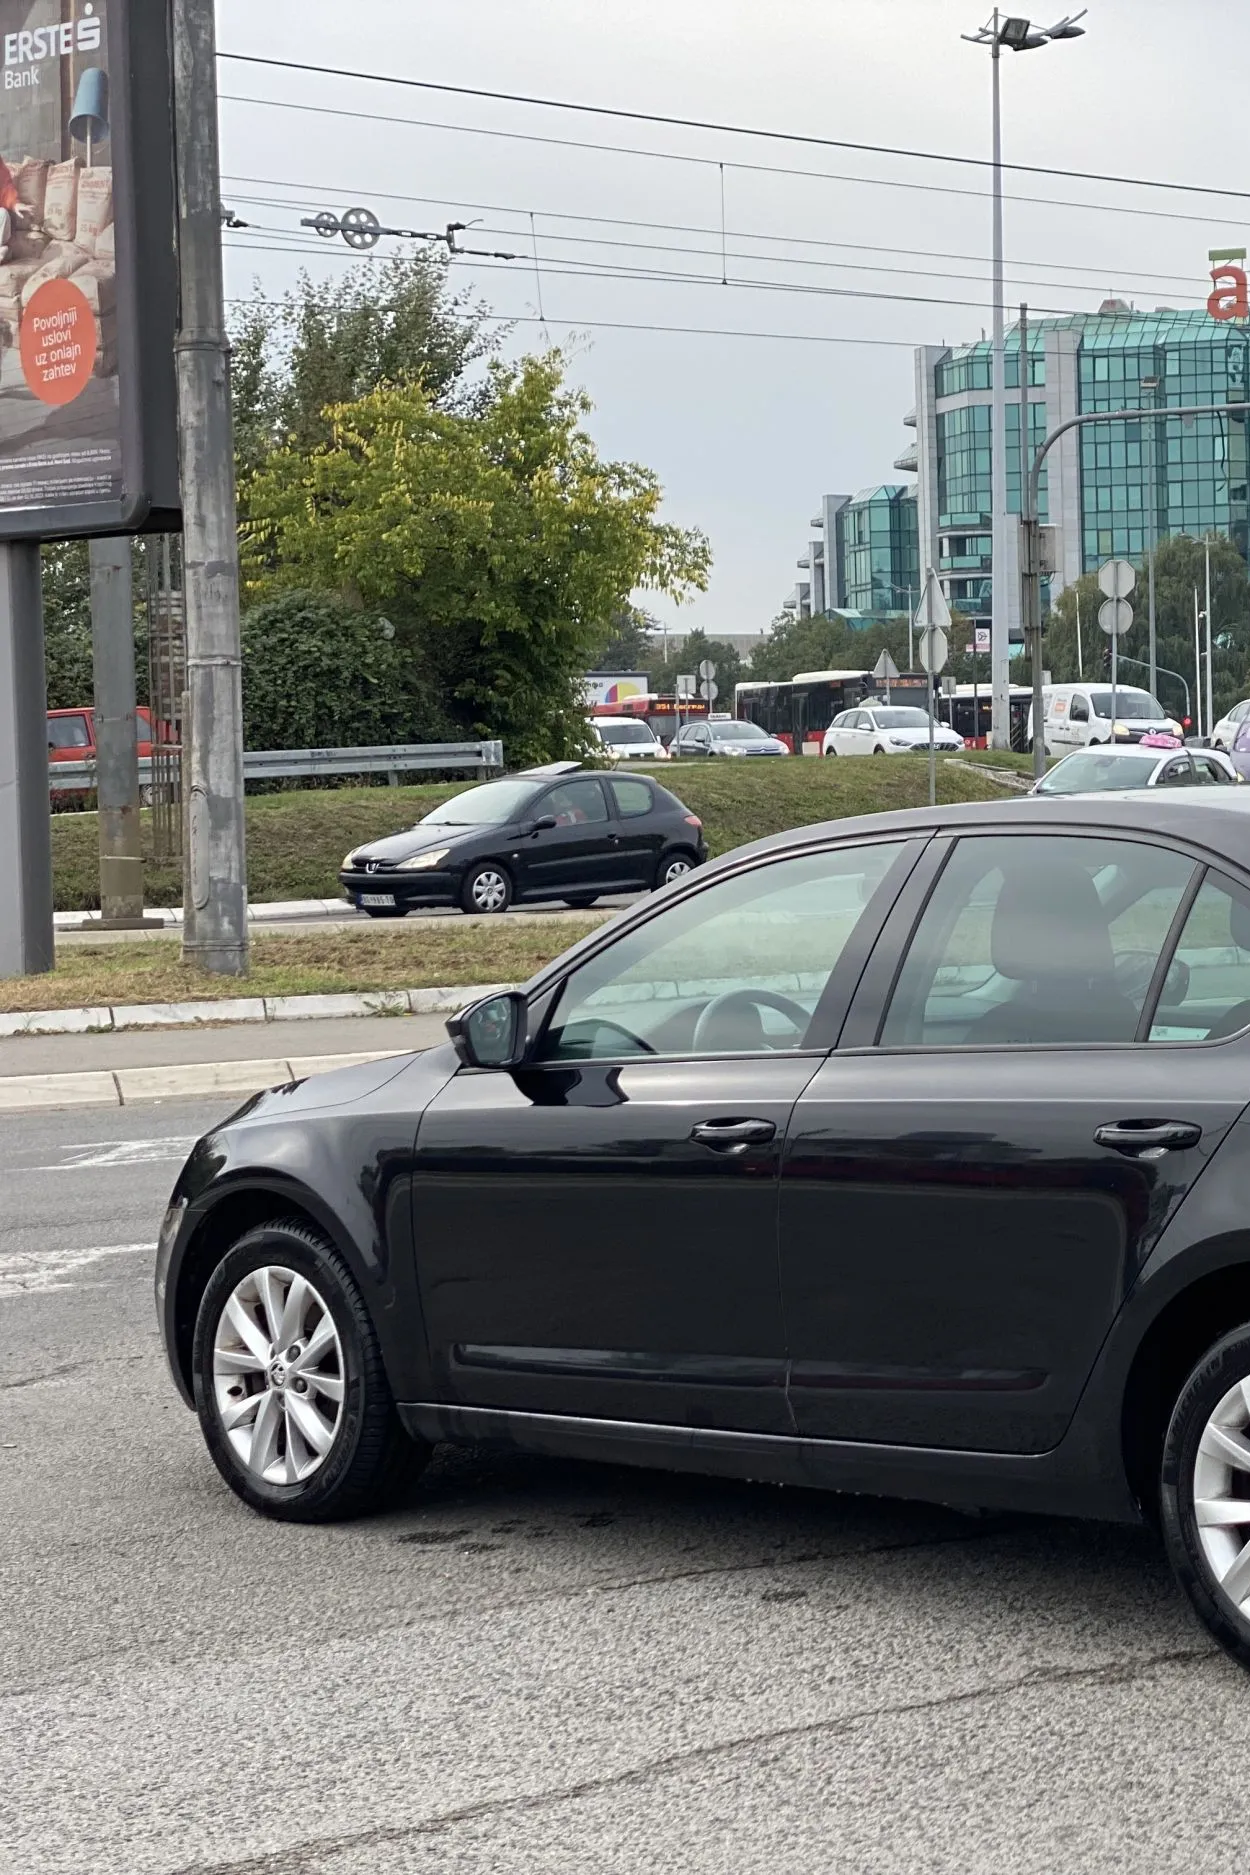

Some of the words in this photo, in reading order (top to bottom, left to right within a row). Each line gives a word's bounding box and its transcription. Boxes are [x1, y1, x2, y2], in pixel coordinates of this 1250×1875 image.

[5, 65, 40, 90] Bank
[33, 306, 78, 333] Povoljniji
[42, 325, 72, 347] uslovi
[35, 353, 47, 366] uz
[50, 342, 81, 361] onlajn
[42, 362, 77, 382] zahtev
